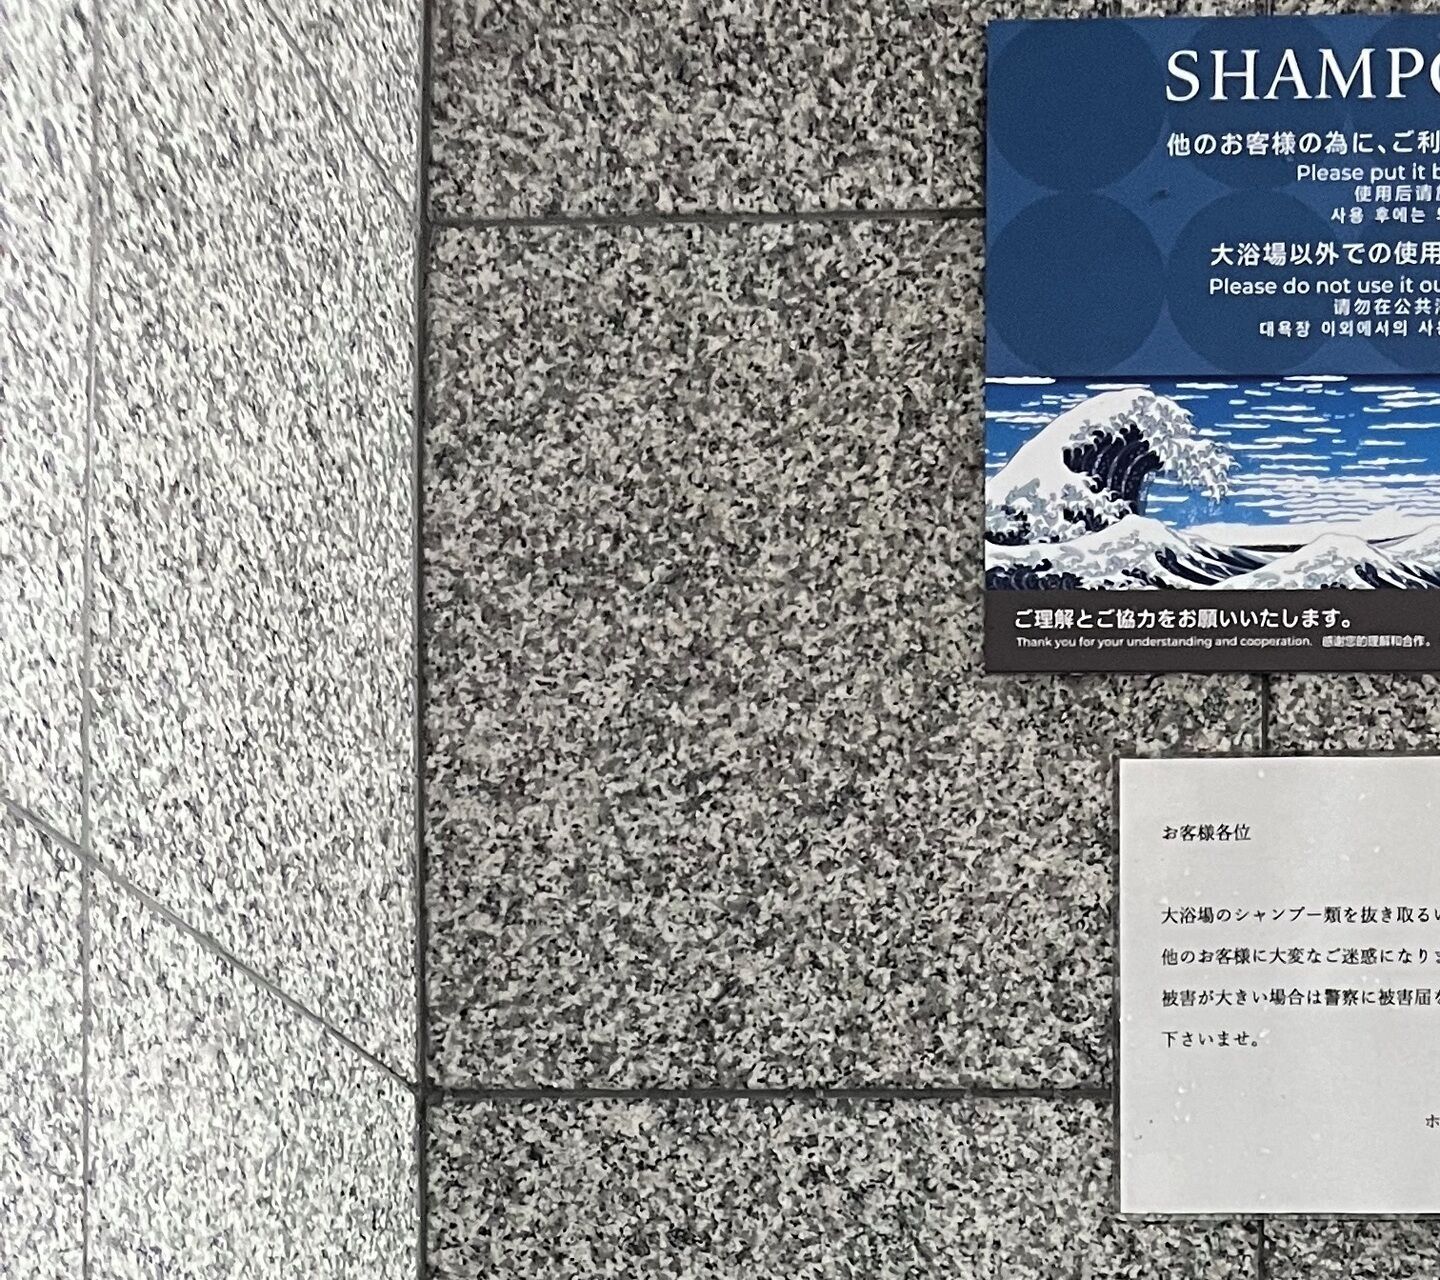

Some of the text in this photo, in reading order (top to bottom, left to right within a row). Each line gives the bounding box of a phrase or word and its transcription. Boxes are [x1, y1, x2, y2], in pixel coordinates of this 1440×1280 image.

[1296, 164, 1364, 181] Please
[1370, 165, 1406, 184] put
[1412, 162, 1425, 180] it
[1330, 206, 1364, 225] 사용
[1374, 206, 1426, 224] 후에는
[1208, 277, 1278, 295] Please
[1282, 276, 1311, 295] do
[1316, 278, 1352, 294] not
[1357, 279, 1394, 294] use
[1400, 275, 1414, 293] it
[1258, 320, 1311, 338] 대욕장
[1320, 319, 1408, 338] 이외에서의
[1014, 608, 1351, 630] ご理解とご協力をお願いいたします。
[1016, 635, 1313, 649] Thank you for your understanding and cooperation.
[1161, 823, 1251, 842] お客様各位
[1161, 1030, 1259, 1048] 下さいませ。
